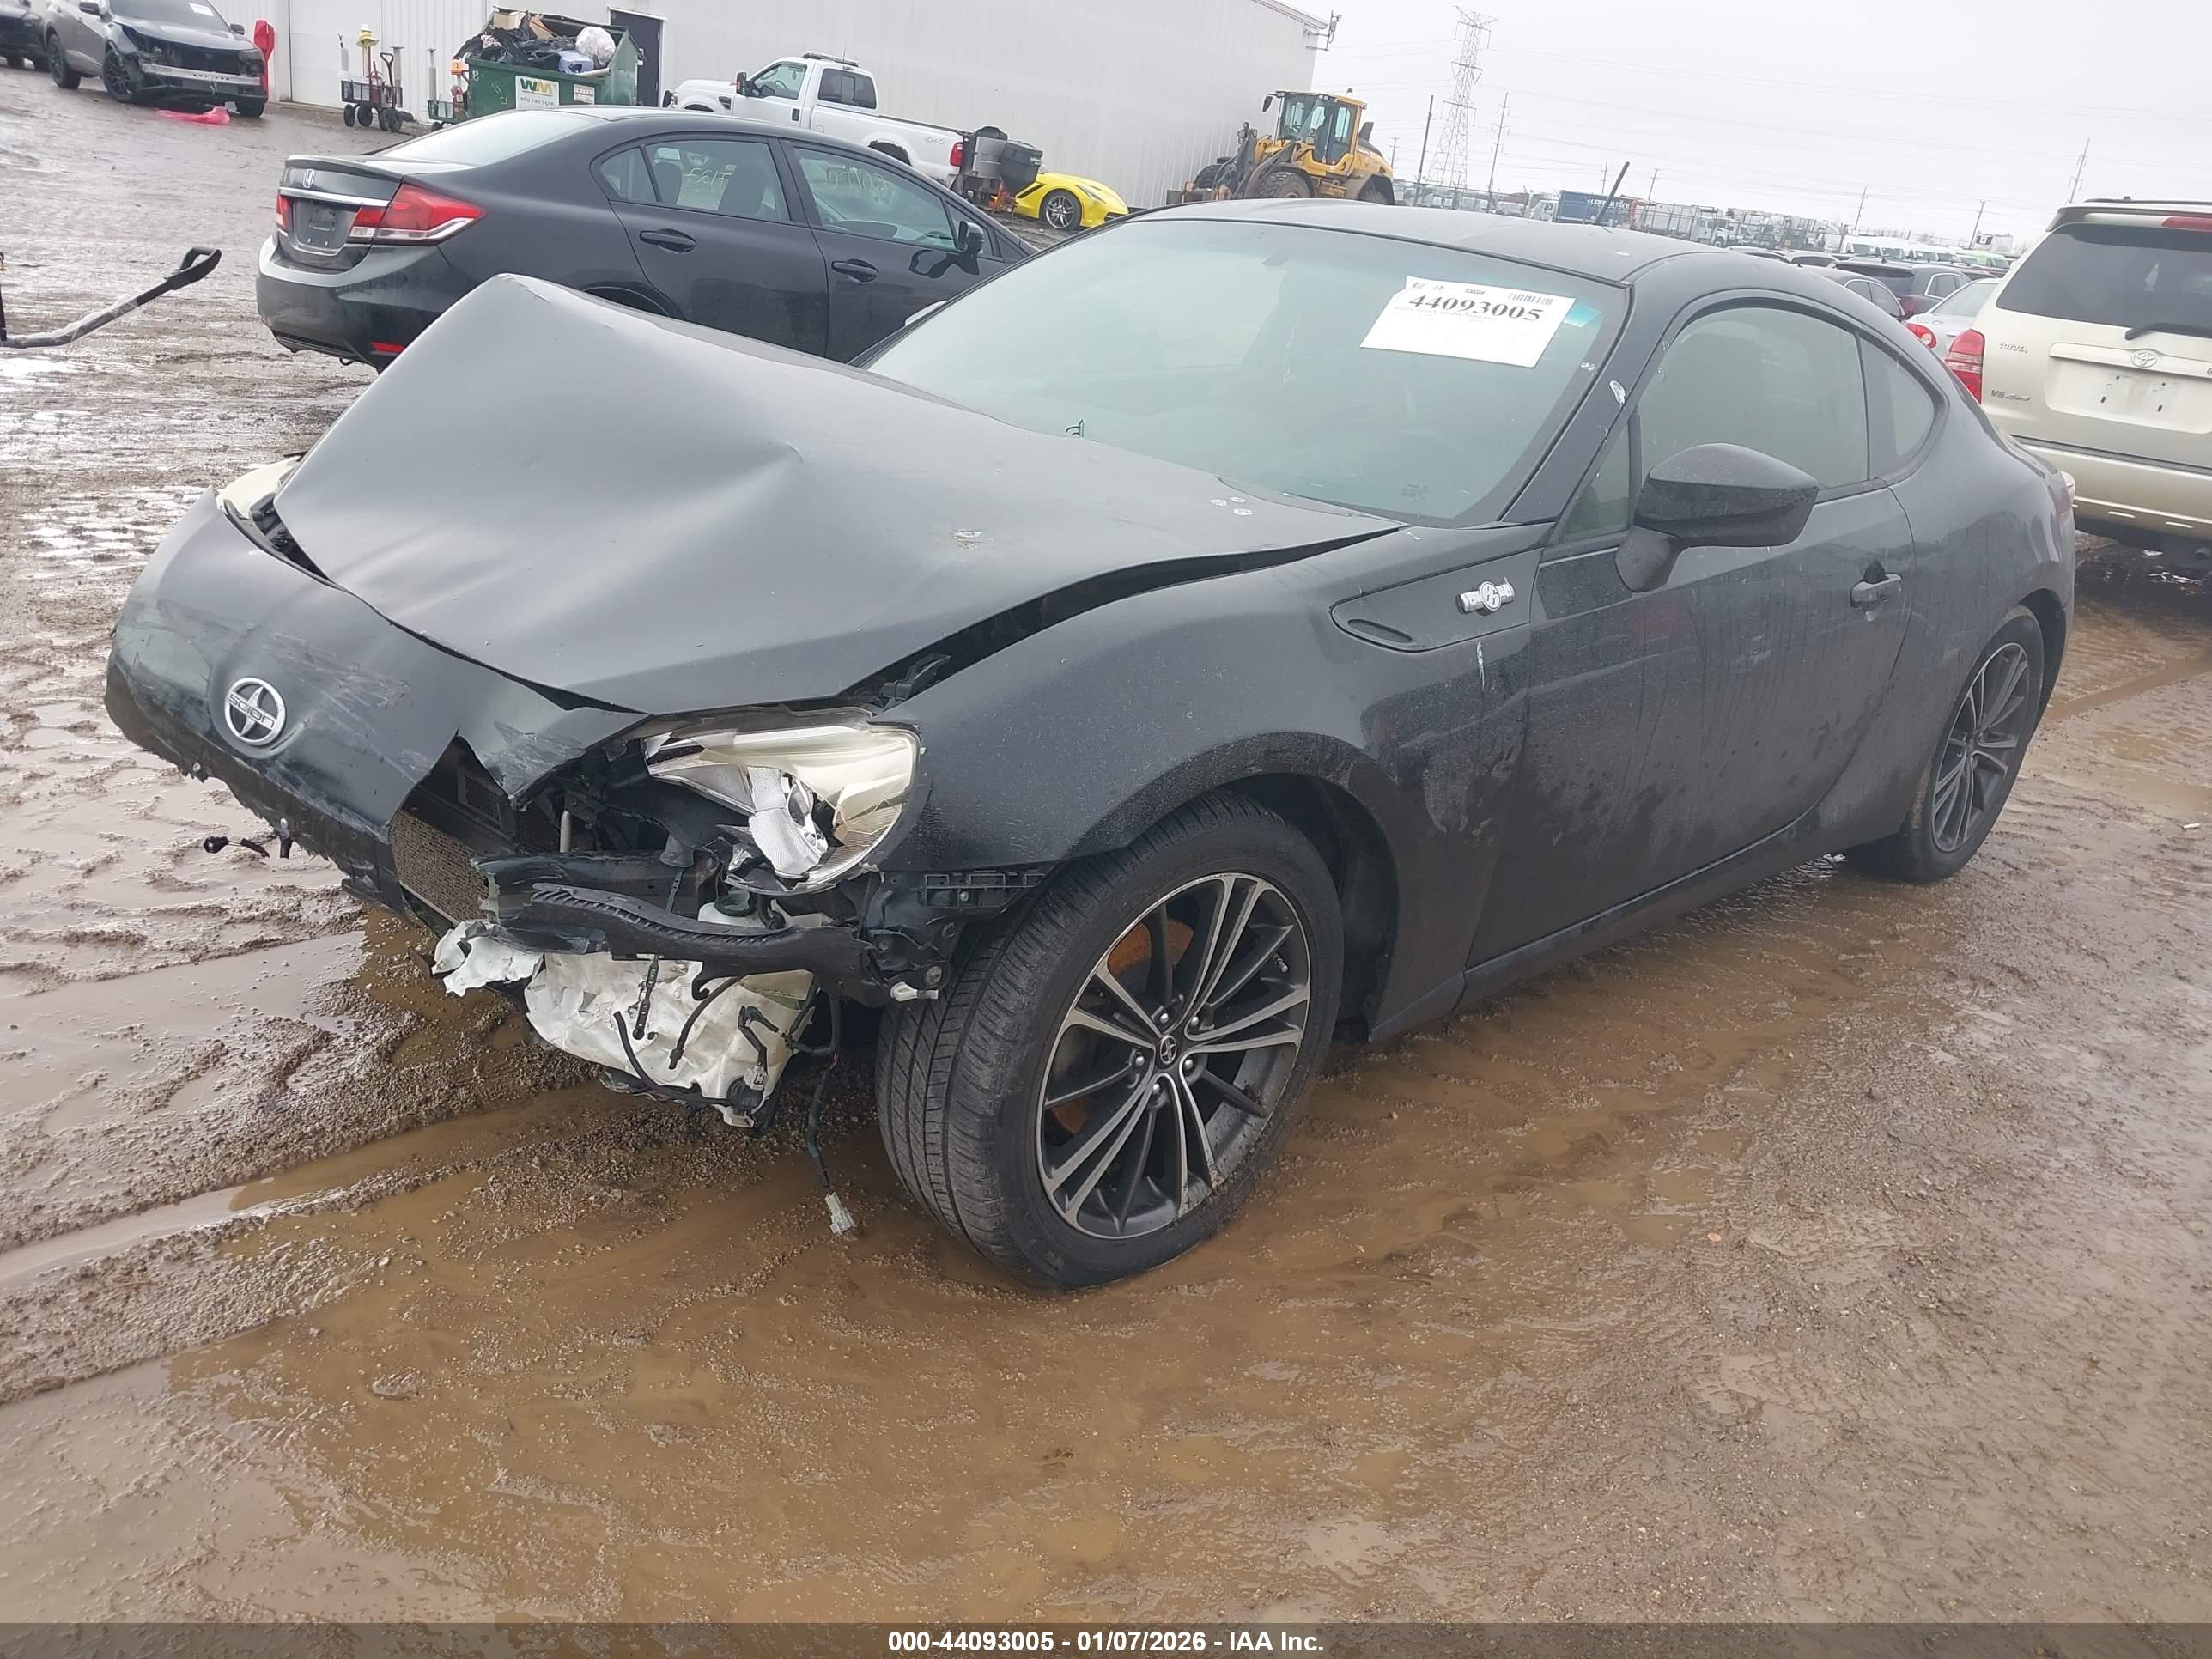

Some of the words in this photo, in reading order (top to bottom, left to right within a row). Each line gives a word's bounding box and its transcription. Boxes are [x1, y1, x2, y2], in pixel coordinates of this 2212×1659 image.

[520, 78, 550, 93] WM
[1408, 295, 1544, 322] 44093005
[1999, 343, 2028, 353] TOYOTA
